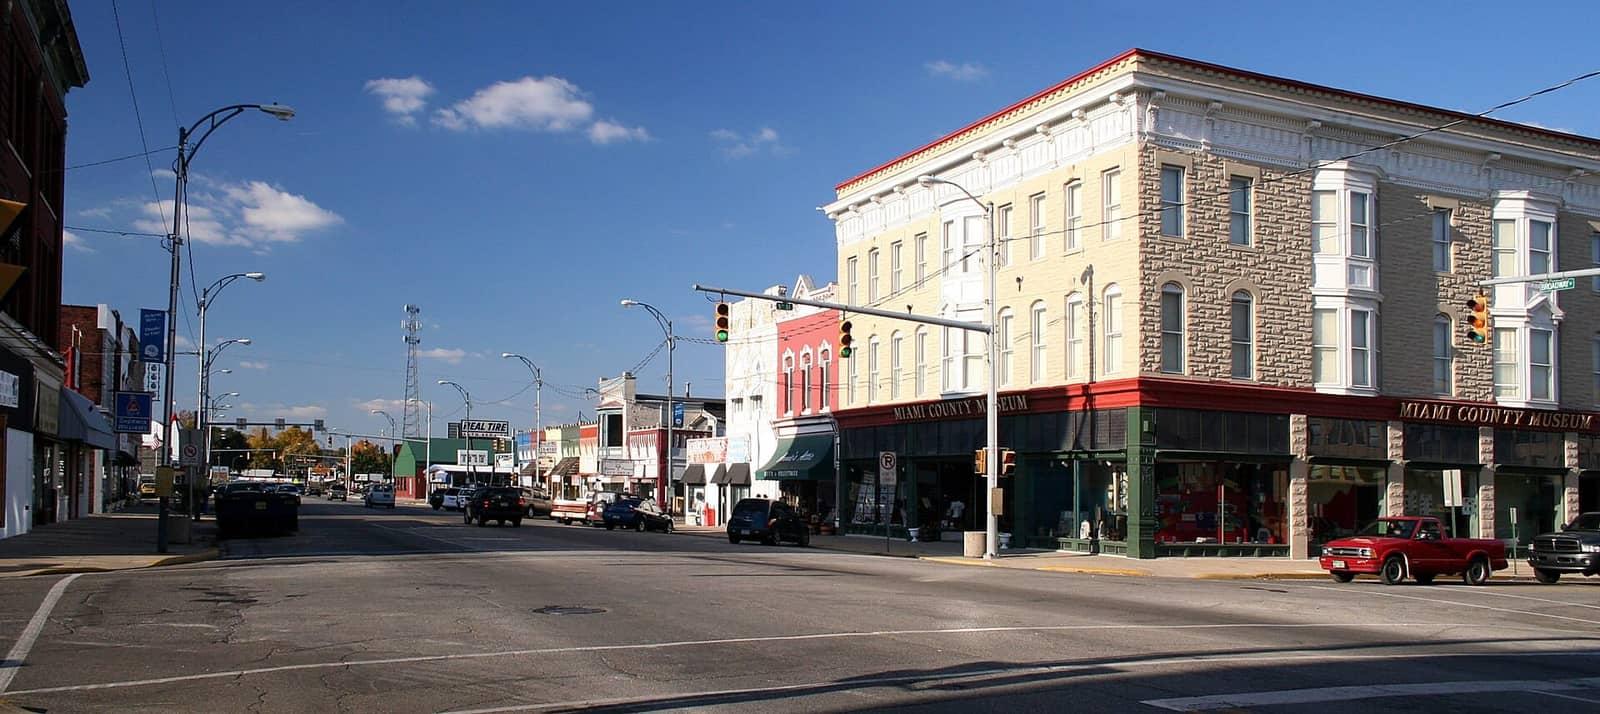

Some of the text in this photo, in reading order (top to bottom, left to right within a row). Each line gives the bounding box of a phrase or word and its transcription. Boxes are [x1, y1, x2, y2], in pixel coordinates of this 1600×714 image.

[894, 394, 1029, 420] MIAMI COUNTY MSEUM
[1399, 402, 1593, 430] MIAMI COUNTY MUSEUM
[487, 423, 507, 432] TIRE
